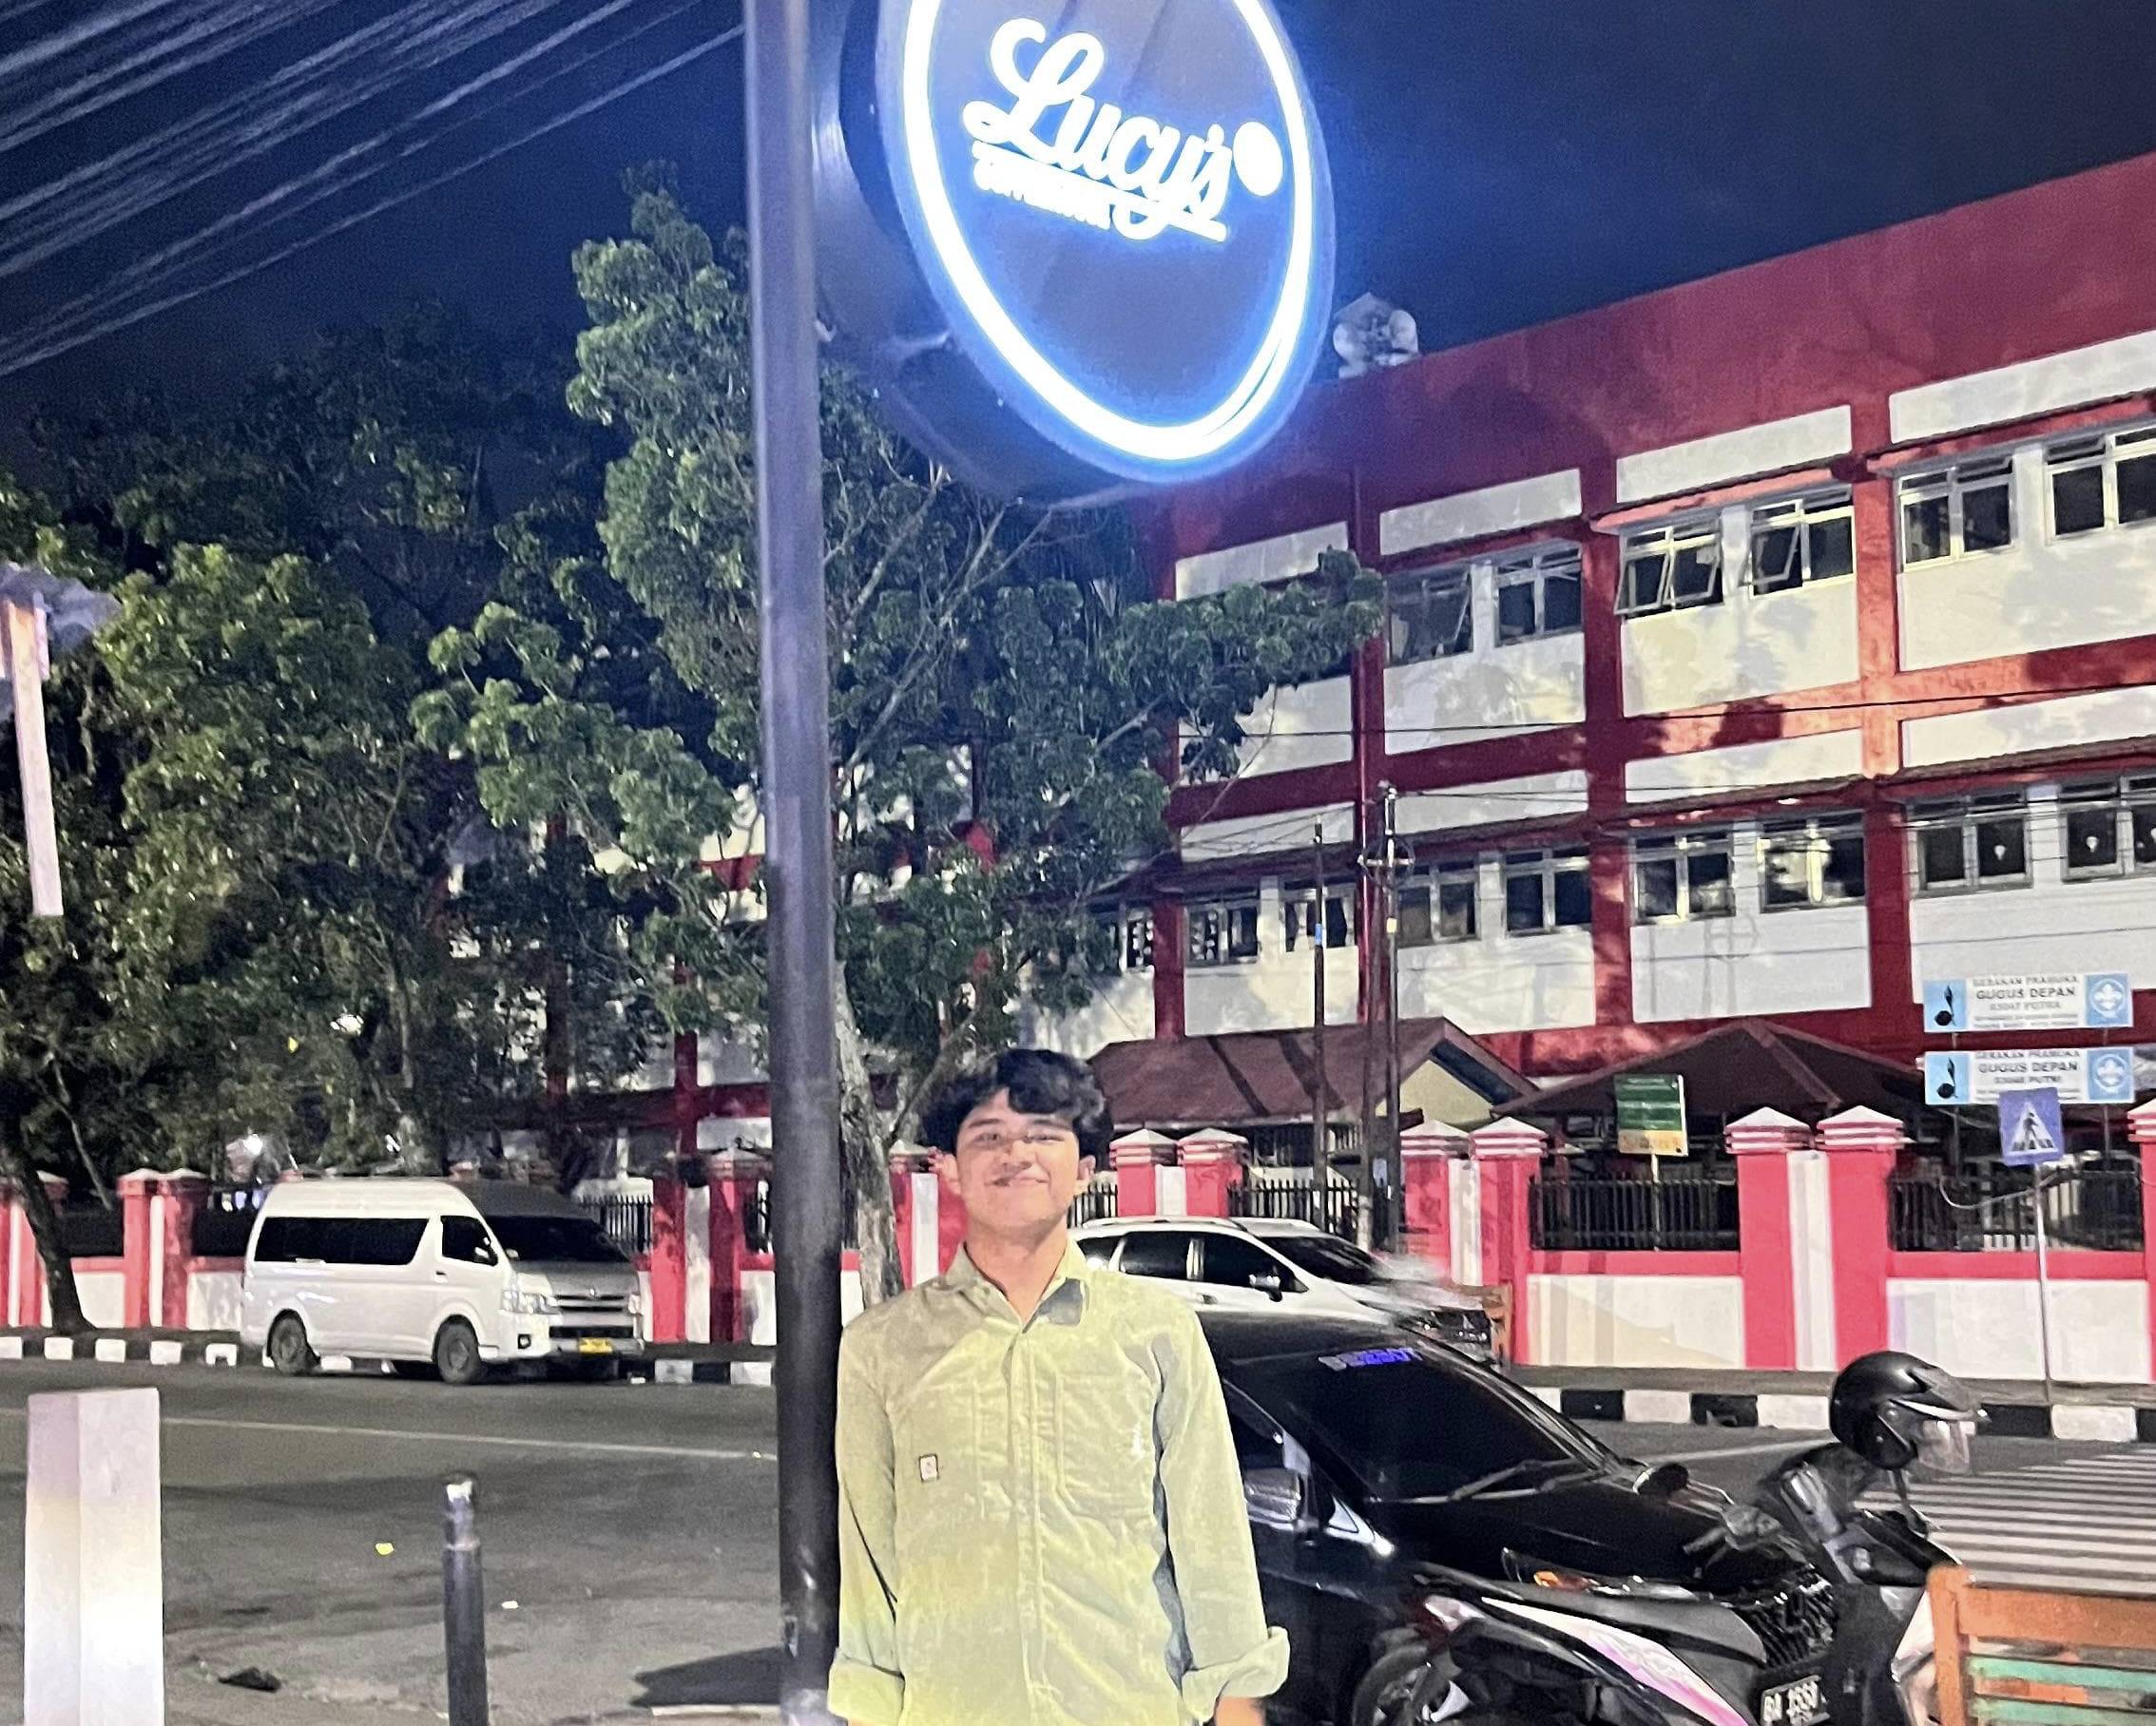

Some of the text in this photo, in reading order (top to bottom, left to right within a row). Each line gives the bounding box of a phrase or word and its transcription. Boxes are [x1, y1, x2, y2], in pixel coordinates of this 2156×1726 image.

[1976, 987, 2075, 1000] GUGUS DEPAN
[1978, 1062, 2078, 1073] GUGUS DEPAN
